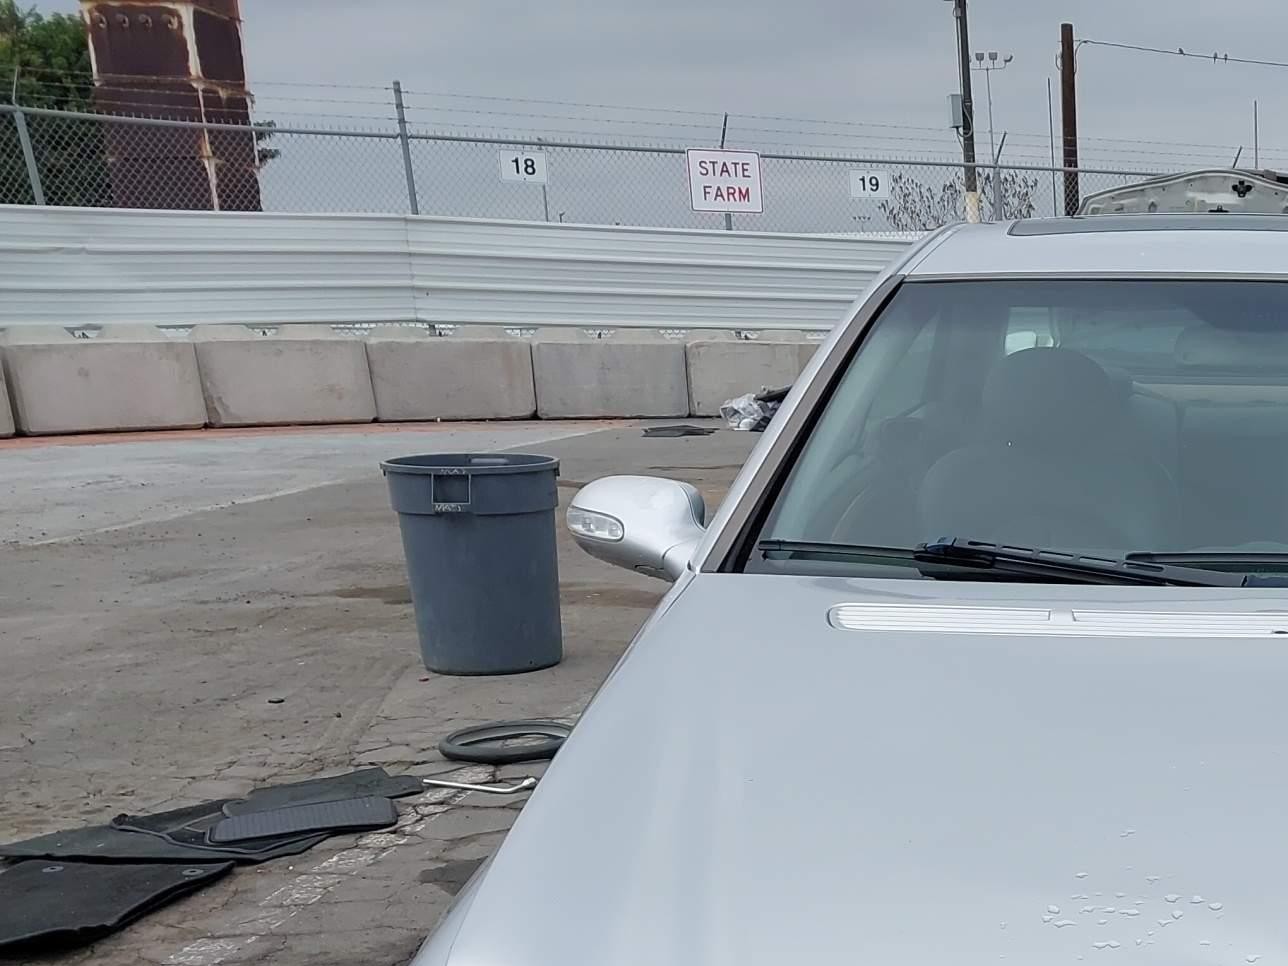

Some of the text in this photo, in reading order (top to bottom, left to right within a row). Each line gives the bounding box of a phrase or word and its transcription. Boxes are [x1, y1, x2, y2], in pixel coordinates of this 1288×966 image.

[511, 158, 536, 176] 18
[699, 160, 752, 179] STATE
[859, 175, 880, 193] 19
[703, 185, 751, 203] FARM
